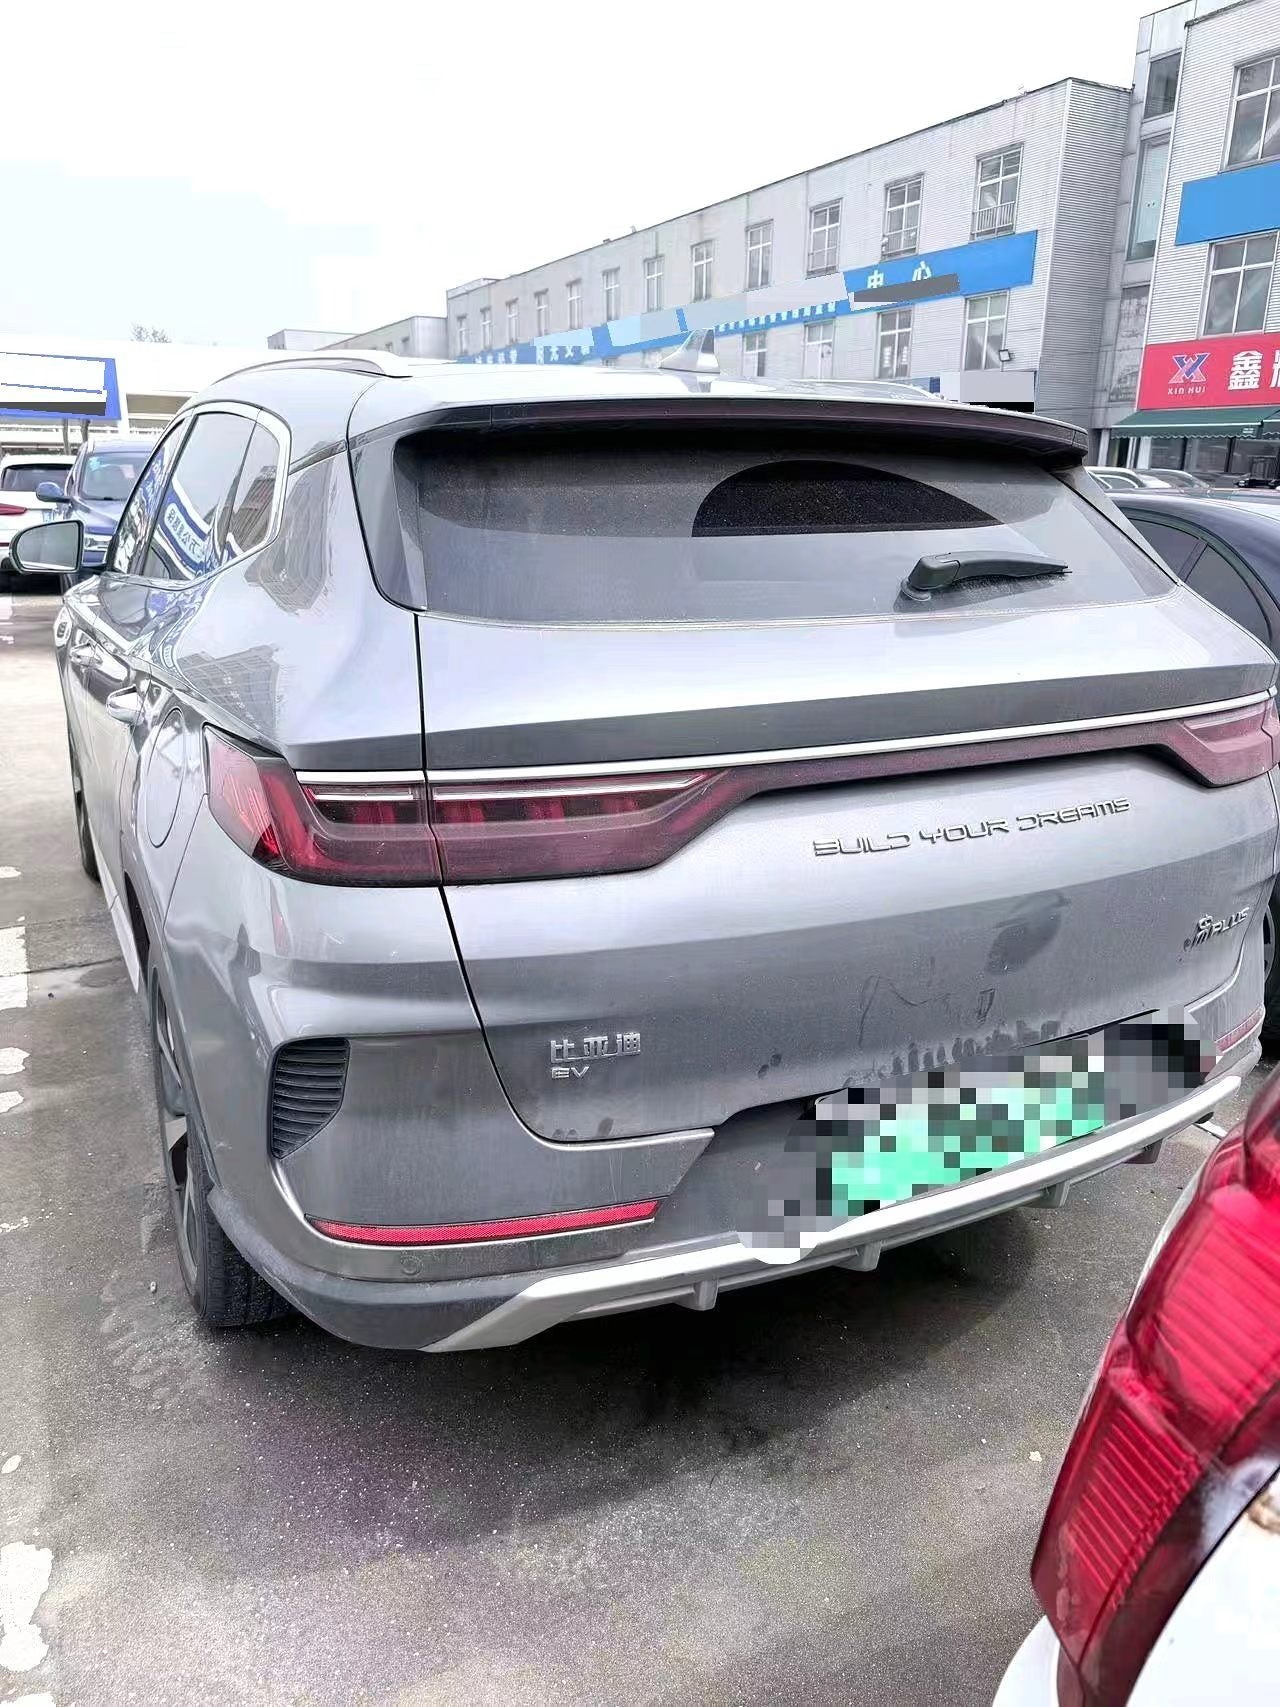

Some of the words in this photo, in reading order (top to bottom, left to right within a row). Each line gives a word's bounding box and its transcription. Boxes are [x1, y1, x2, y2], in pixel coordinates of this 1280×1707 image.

[1168, 387, 1184, 395] XIN
[1188, 386, 1206, 395] HUI
[812, 832, 911, 857] BUILD
[918, 817, 1010, 844] YOUR
[1016, 797, 1132, 832] DREAMS
[550, 1032, 641, 1063] 比亚迪
[551, 1066, 590, 1079] EV
